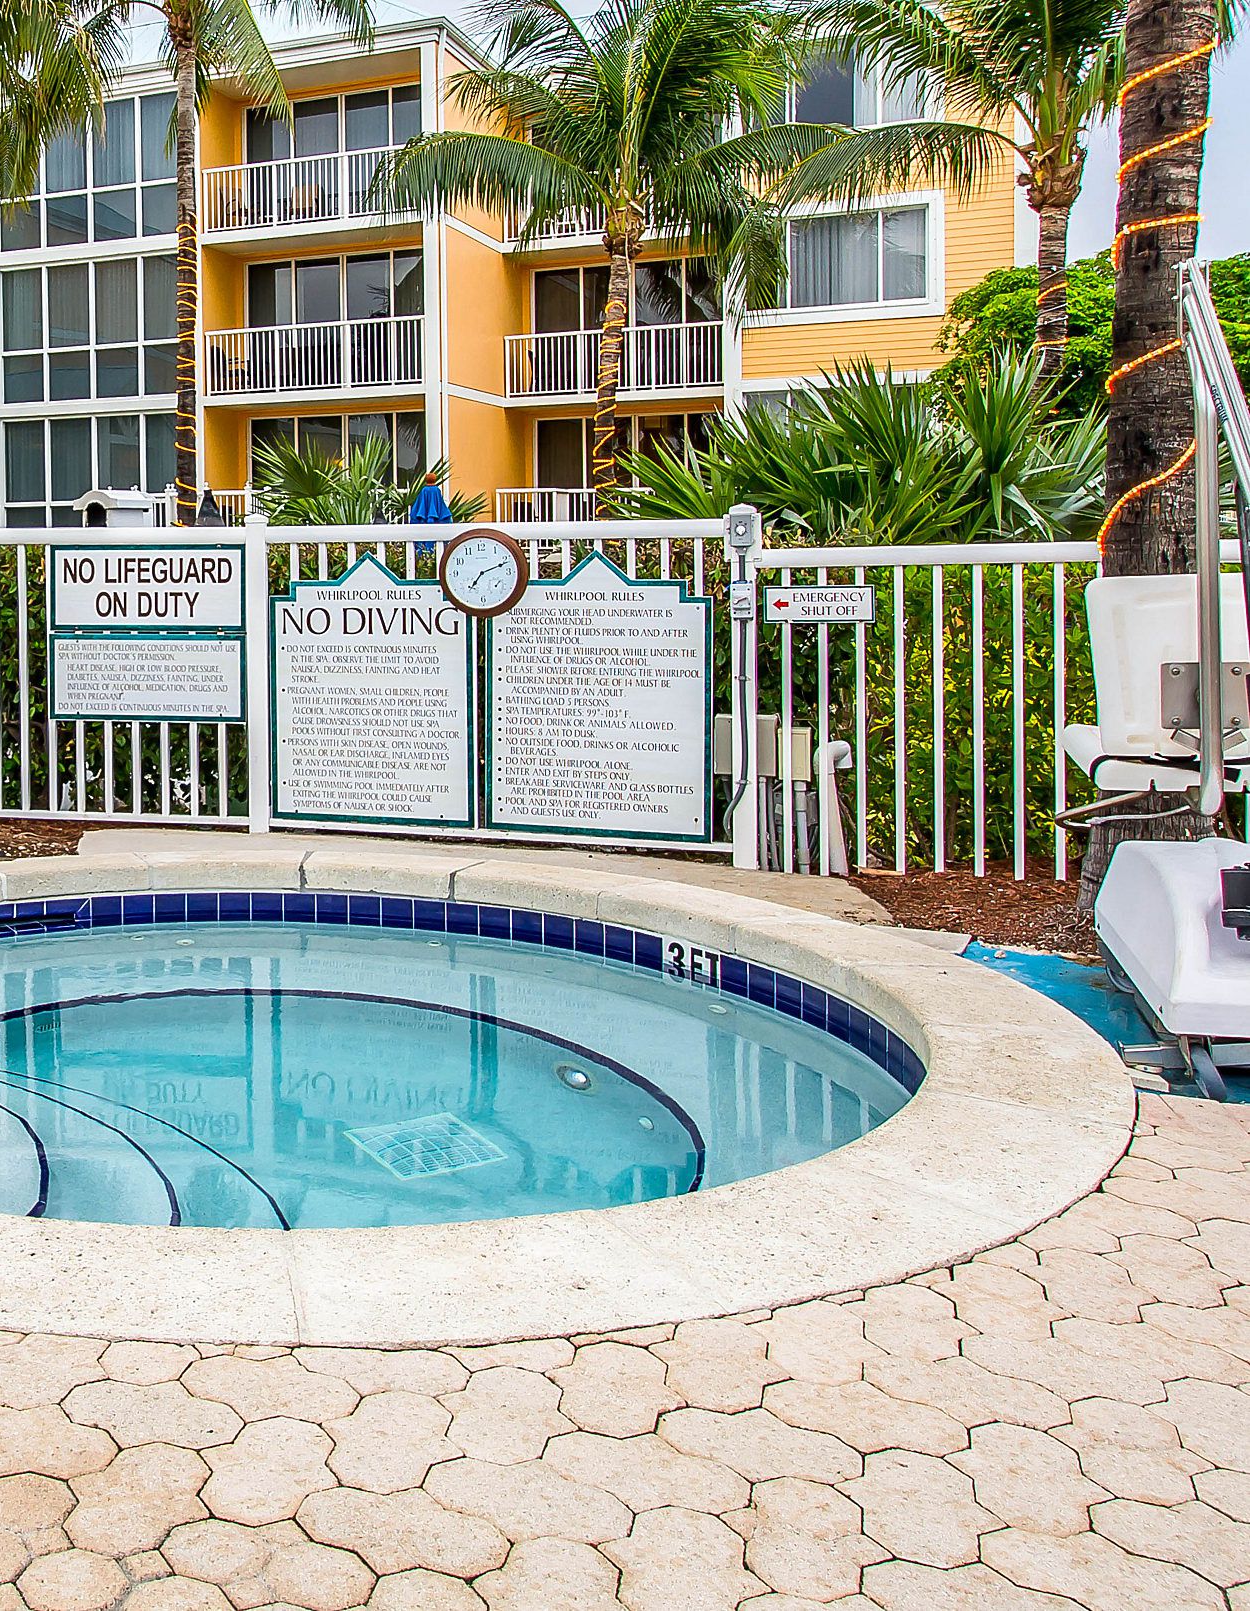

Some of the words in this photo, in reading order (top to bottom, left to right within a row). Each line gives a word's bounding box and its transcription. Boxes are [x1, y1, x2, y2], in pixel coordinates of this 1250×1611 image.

[464, 547, 472, 555] 11
[493, 546, 497, 554] 1
[63, 558, 95, 583] NO
[105, 558, 233, 583] LIFEGUARD
[317, 590, 382, 600] WHIRLPOOL
[387, 590, 421, 600] RULES
[545, 592, 607, 601] WHIRLPOOL
[612, 592, 644, 602] RULES
[793, 592, 866, 602] EMERGENCY
[96, 592, 127, 617] ON
[137, 592, 199, 617] DUTY
[559, 609, 580, 617] YOUR
[582, 609, 605, 617] HEAD
[801, 606, 832, 616] SHUT
[836, 606, 858, 616] OFF
[282, 607, 330, 635] NO
[342, 607, 459, 635] DIVING
[511, 617, 527, 625] NOT
[506, 627, 529, 635] DRINK
[561, 628, 571, 636] OF
[574, 628, 600, 636] FLUIDS
[603, 629, 625, 637] PRIOR
[628, 629, 639, 637] TO
[641, 629, 659, 637] AND
[663, 629, 688, 638] AFTER
[287, 645, 298, 653] DO
[300, 645, 314, 653] NOT
[317, 645, 342, 653] EXCEED
[403, 646, 436, 654] MINUTES
[506, 646, 518, 654] DO
[521, 646, 537, 654] NOT
[556, 647, 571, 655] THE
[573, 647, 620, 656] WHIRLPOOL
[623, 648, 648, 656] WHILE
[651, 649, 679, 657] UNDER
[681, 649, 697, 657] THE
[511, 656, 550, 664] INFLUENCE
[566, 657, 593, 665] DRUGS
[595, 657, 606, 665] OR
[511, 686, 569, 695] ACCOMPANIED
[571, 688, 580, 696] BY
[583, 688, 595, 696] AN
[119, 703, 160, 711] CONTINUOUS
[506, 707, 519, 715] SPA
[330, 708, 369, 716] NARCOTICS
[372, 708, 381, 716] OR
[384, 709, 408, 717] OTHER
[411, 709, 435, 717] DRUGS
[438, 710, 457, 718] THAT
[506, 717, 517, 725] NO
[547, 718, 572, 727] DRINK
[574, 719, 585, 727] OR
[588, 720, 626, 729] ANIMALS
[630, 721, 676, 730] ALLOWED.
[292, 727, 314, 735] POOLS
[317, 728, 350, 736] WITHOUT
[353, 728, 370, 737] FIRST
[373, 729, 417, 738] CONSULTING
[419, 730, 425, 738] A
[538, 728, 542, 737] 8
[546, 729, 559, 737] AM
[562, 729, 572, 737] TO
[575, 730, 597, 738] DUSK.
[506, 737, 518, 746] NO
[520, 738, 554, 747] OUTSIDE
[557, 739, 581, 748] FOOD,
[584, 740, 614, 750] DRINKS
[616, 742, 628, 750] OR
[631, 742, 680, 752] ALCOHOLIC
[293, 749, 316, 757] NASAL
[318, 749, 328, 757] OR
[392, 751, 430, 760] INFLAMED
[432, 752, 449, 760] EYES
[506, 757, 518, 765] DO
[521, 758, 537, 766] NOT
[540, 758, 553, 767] USE
[556, 759, 601, 768] WHIRLPOOL
[506, 768, 530, 776] ENTER
[532, 769, 550, 777] AND
[553, 769, 569, 778] EXIT
[573, 770, 582, 778] BY
[585, 771, 607, 780] STEPS
[506, 778, 550, 787] BREAKABLE
[552, 780, 605, 790] SERVICEWARE
[609, 782, 627, 791] AND
[630, 783, 655, 792] GLASS
[657, 784, 694, 794] BOTTLES
[293, 800, 331, 810] SYMPTOMS
[334, 801, 342, 810] OF
[345, 802, 373, 811] NAUSEA
[375, 803, 386, 811] OR
[506, 797, 526, 806] POOL
[529, 798, 547, 807] AND
[549, 799, 562, 808] SPA
[565, 800, 580, 809] FOR
[583, 801, 630, 811] REGISTERED
[633, 803, 669, 813] OWNERS
[511, 807, 528, 816] AND
[531, 808, 560, 817] GUESTS
[562, 809, 576, 818] USE
